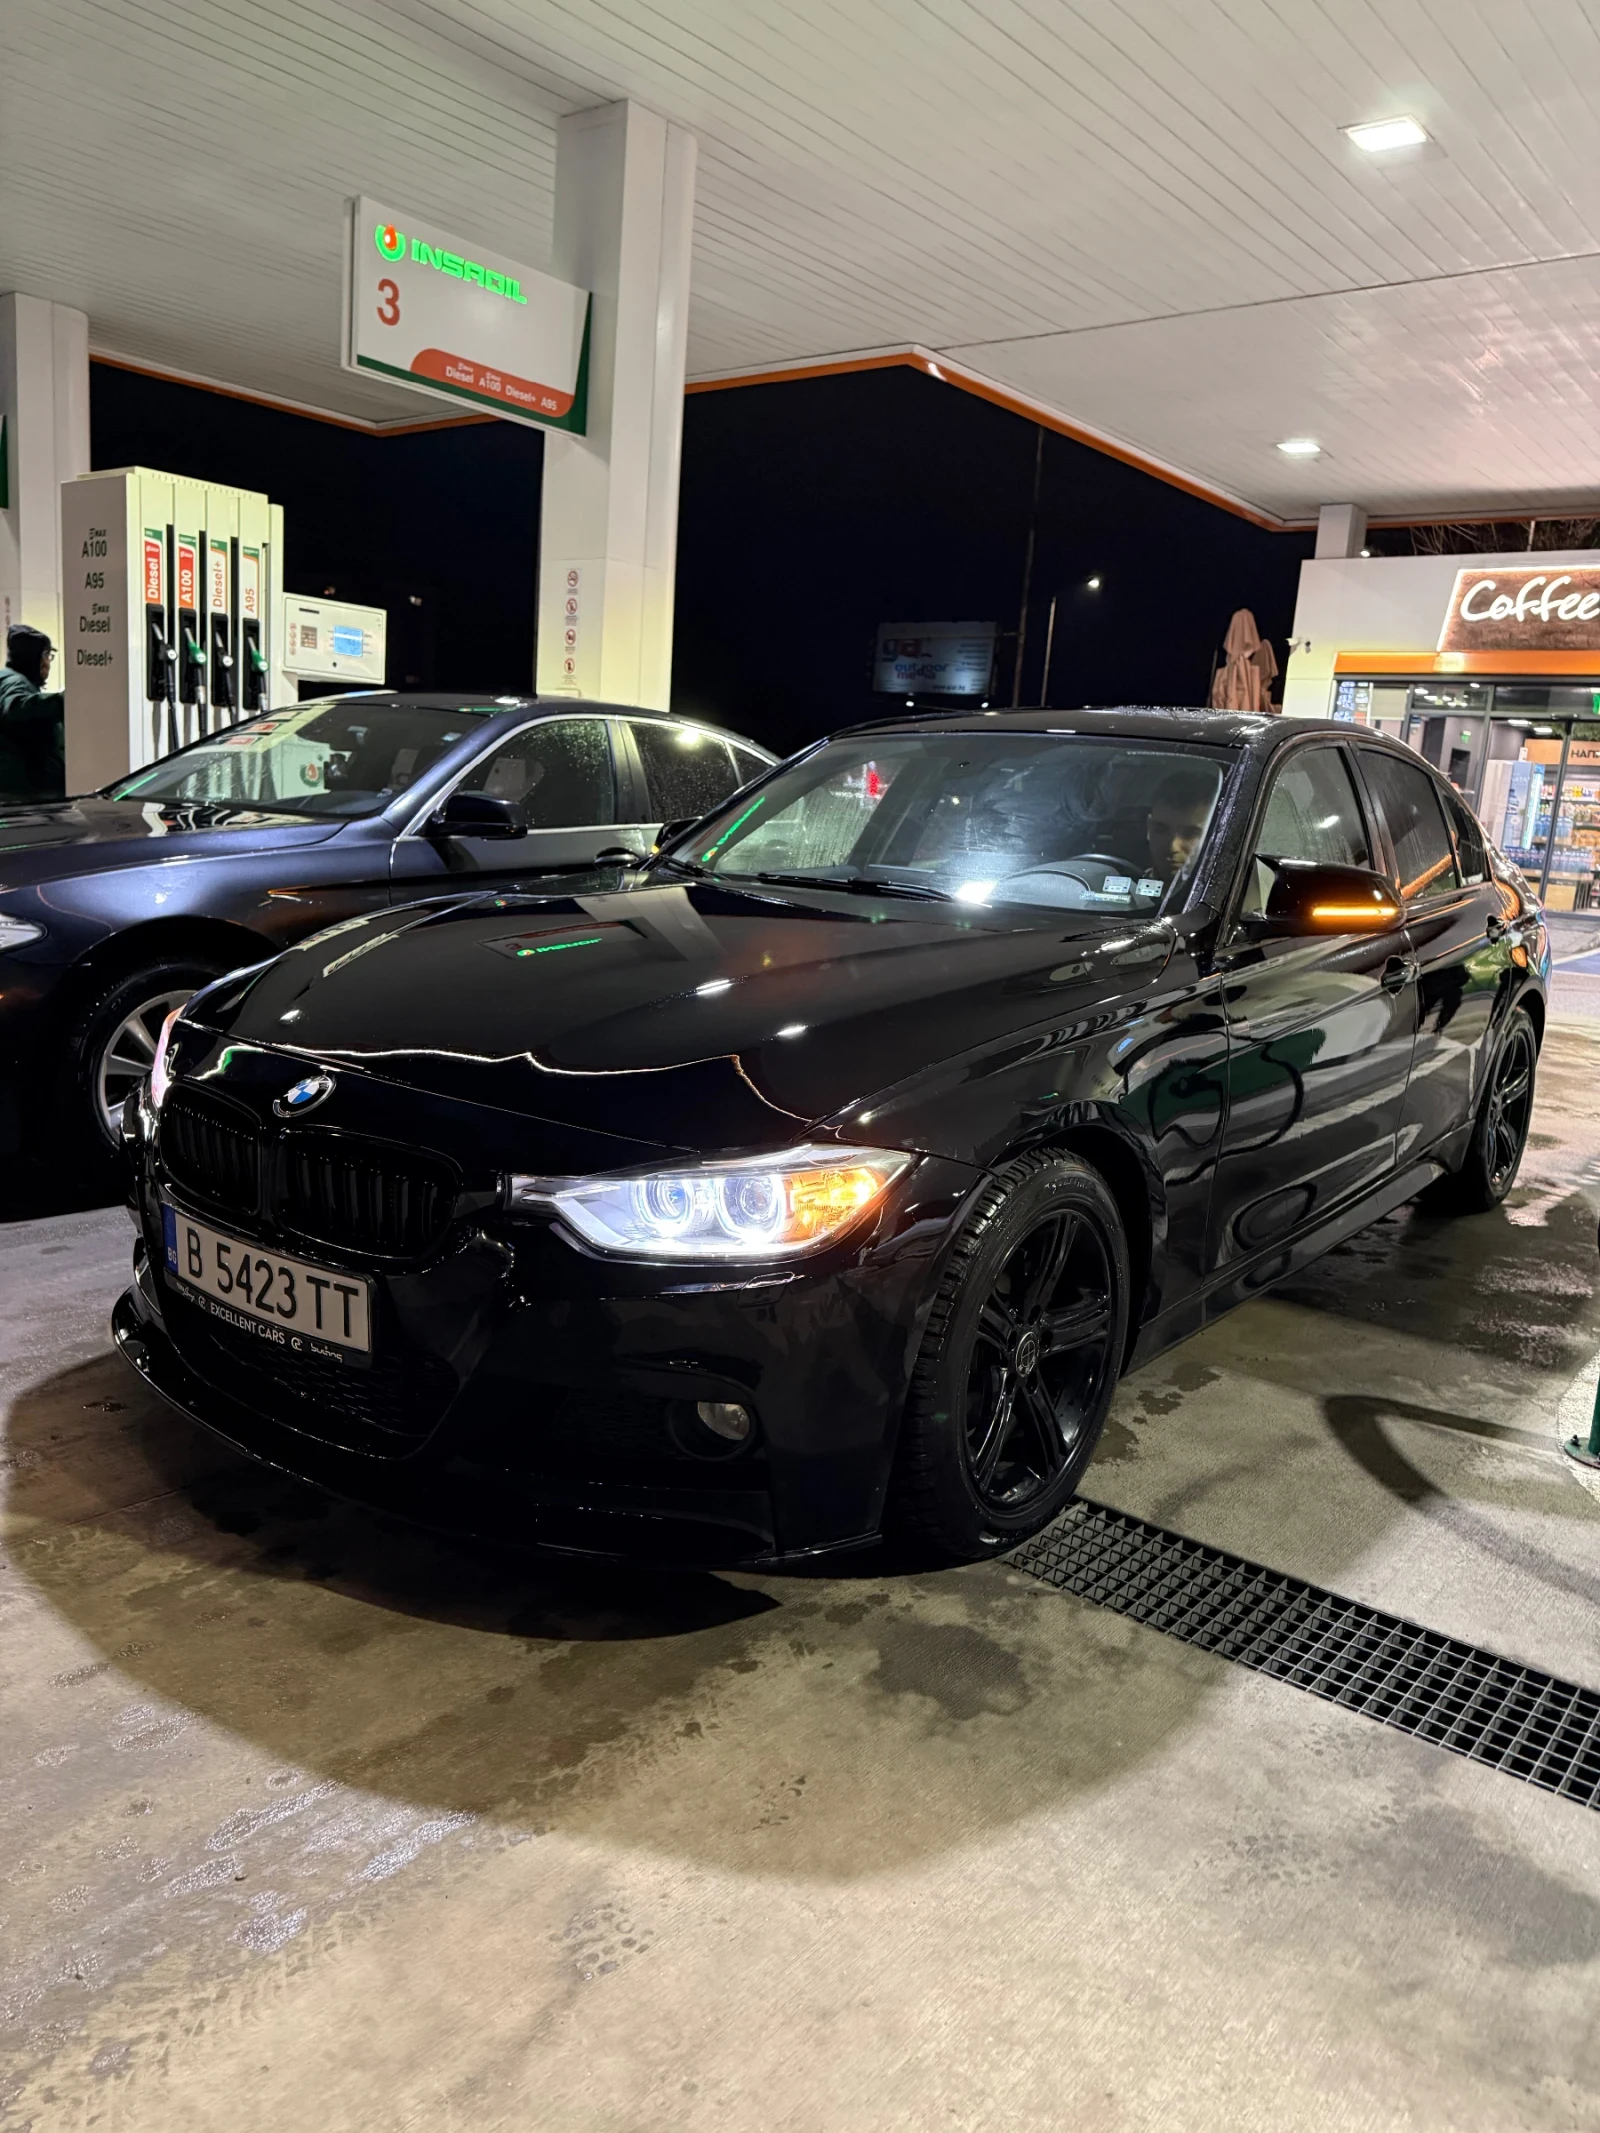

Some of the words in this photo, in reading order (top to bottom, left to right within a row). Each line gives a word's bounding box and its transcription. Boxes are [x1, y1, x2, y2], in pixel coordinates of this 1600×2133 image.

[377, 278, 400, 327] 3
[445, 365, 475, 384] Diesel
[478, 377, 502, 393] A100
[505, 385, 537, 403] Diesel+
[540, 397, 557, 411] A95
[81, 540, 108, 558] A100
[84, 572, 105, 589] A95
[146, 557, 159, 600] Diesel
[180, 569, 193, 604] A100
[212, 561, 223, 608] Diesel+
[244, 588, 255, 613] A95
[1460, 575, 1600, 622] Coffee
[79, 616, 111, 633] Diesel
[76, 649, 114, 666] Diesel+
[167, 1247, 178, 1265] BG
[186, 1226, 203, 1279] B
[216, 1241, 298, 1320] 5423
[306, 1274, 359, 1338] TT
[210, 1302, 257, 1334] EXCELLENT
[258, 1324, 286, 1345] CARS
